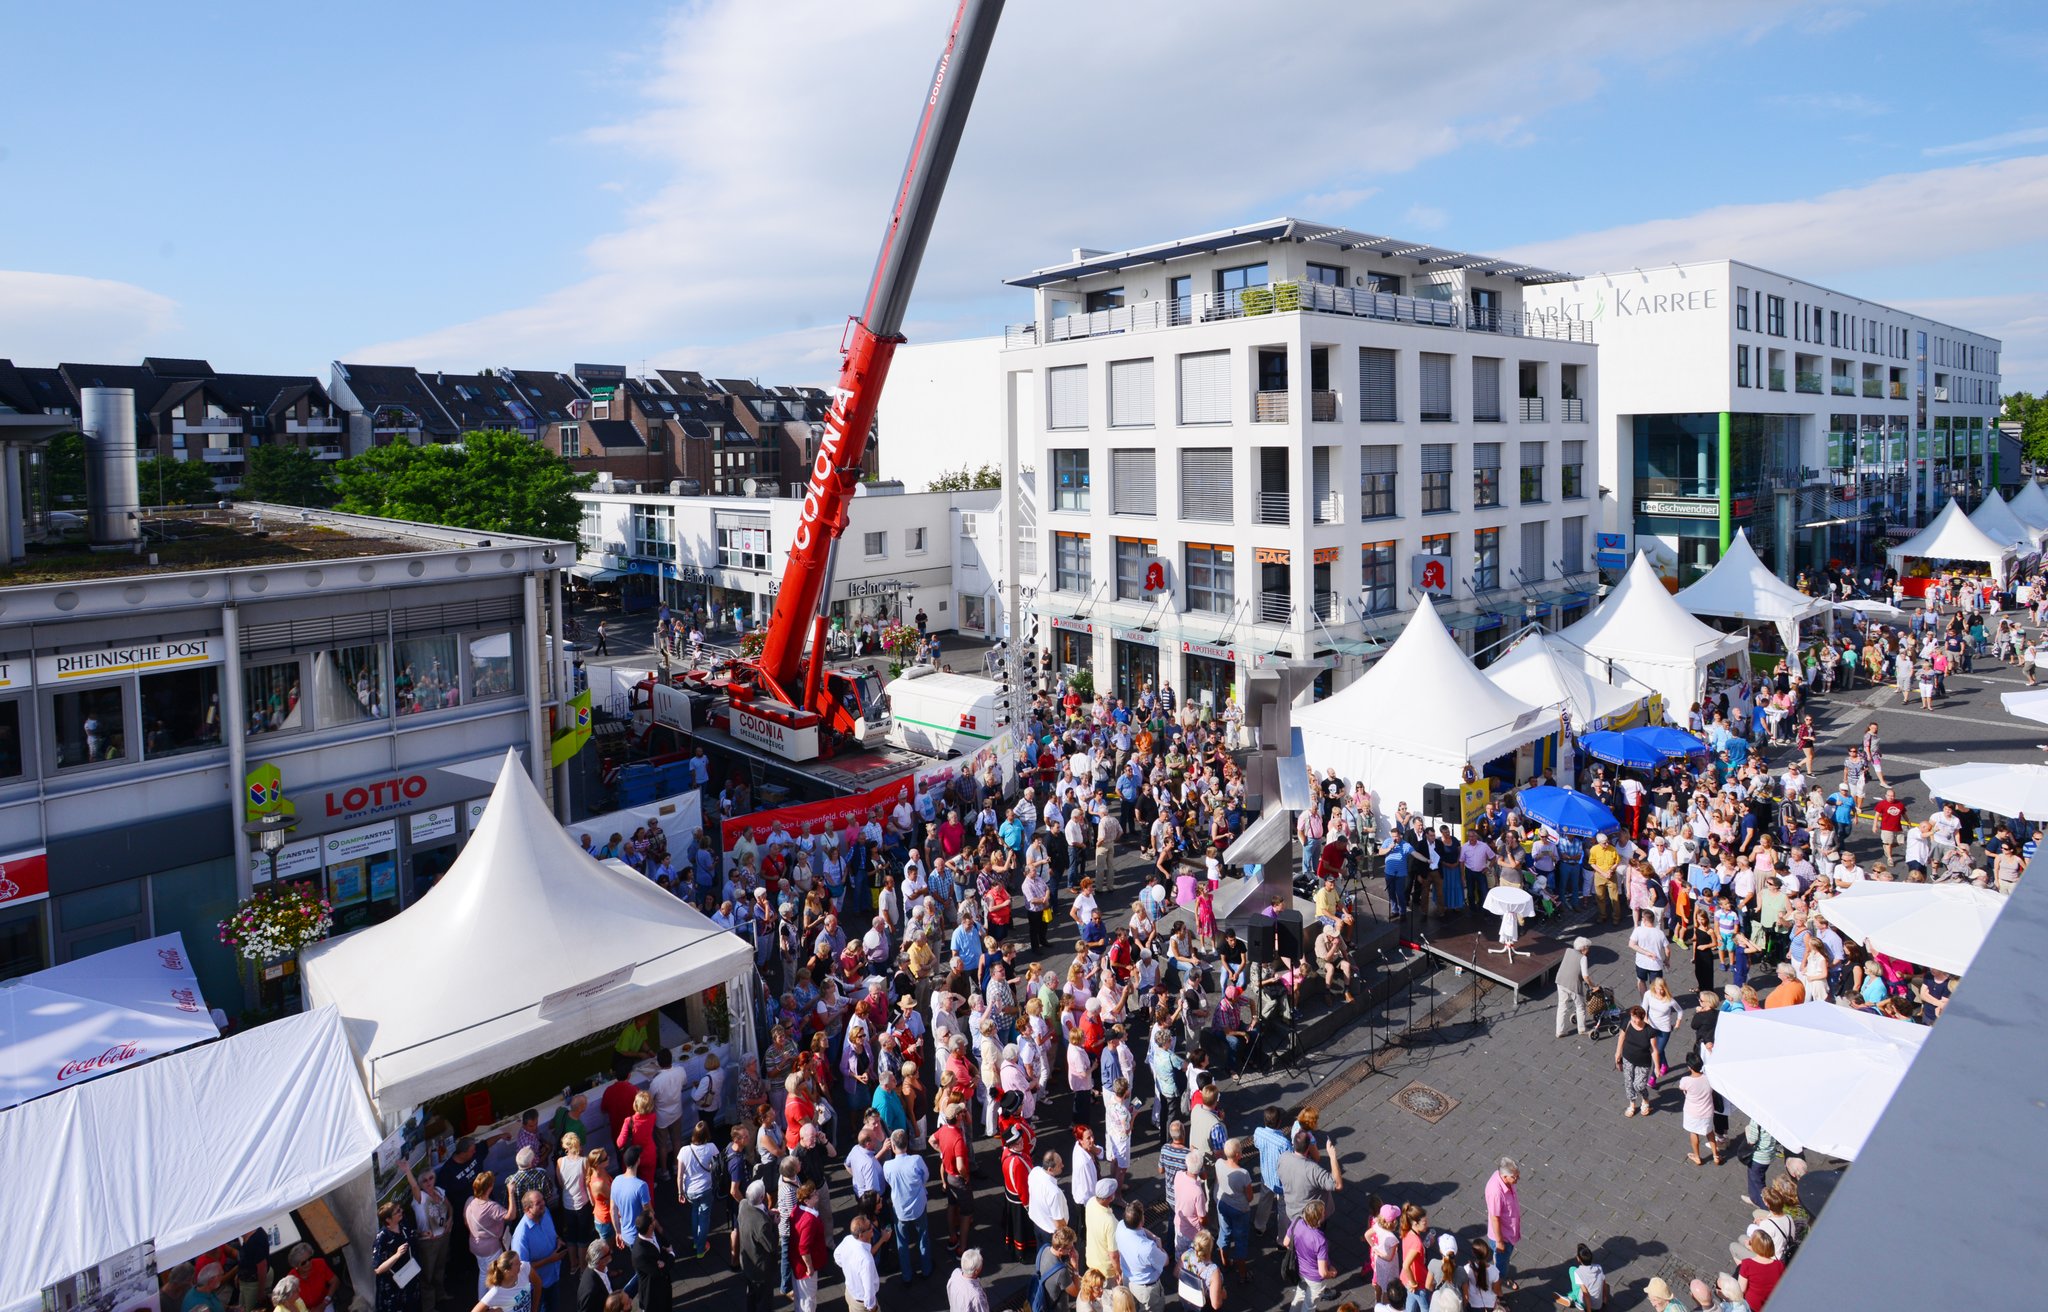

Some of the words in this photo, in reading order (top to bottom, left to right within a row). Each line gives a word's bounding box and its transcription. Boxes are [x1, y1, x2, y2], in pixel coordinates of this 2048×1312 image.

[930, 54, 950, 105] COLONIA
[1616, 288, 1718, 318] KARREE
[795, 387, 855, 550] COLONIA
[1659, 503, 1716, 514] Gschwendner
[1060, 620, 1085, 632] APOTHEKE
[1126, 632, 1144, 641] ADLER
[57, 647, 161, 672] RHEINISCHE
[167, 640, 208, 658] POST
[1192, 645, 1225, 657] APOTHEKE
[739, 713, 784, 742] COLONIA
[740, 728, 785, 752] SPEZIALFAHRZEUGE
[325, 775, 428, 817] LOTTO
[344, 811, 367, 821] am
[370, 800, 413, 815] Markt
[340, 828, 394, 846] DAMPFANSTALT
[260, 846, 319, 866] DAPFANSTALT
[57, 1040, 141, 1081] Coca-Cola
[114, 1267, 132, 1278] Olive
